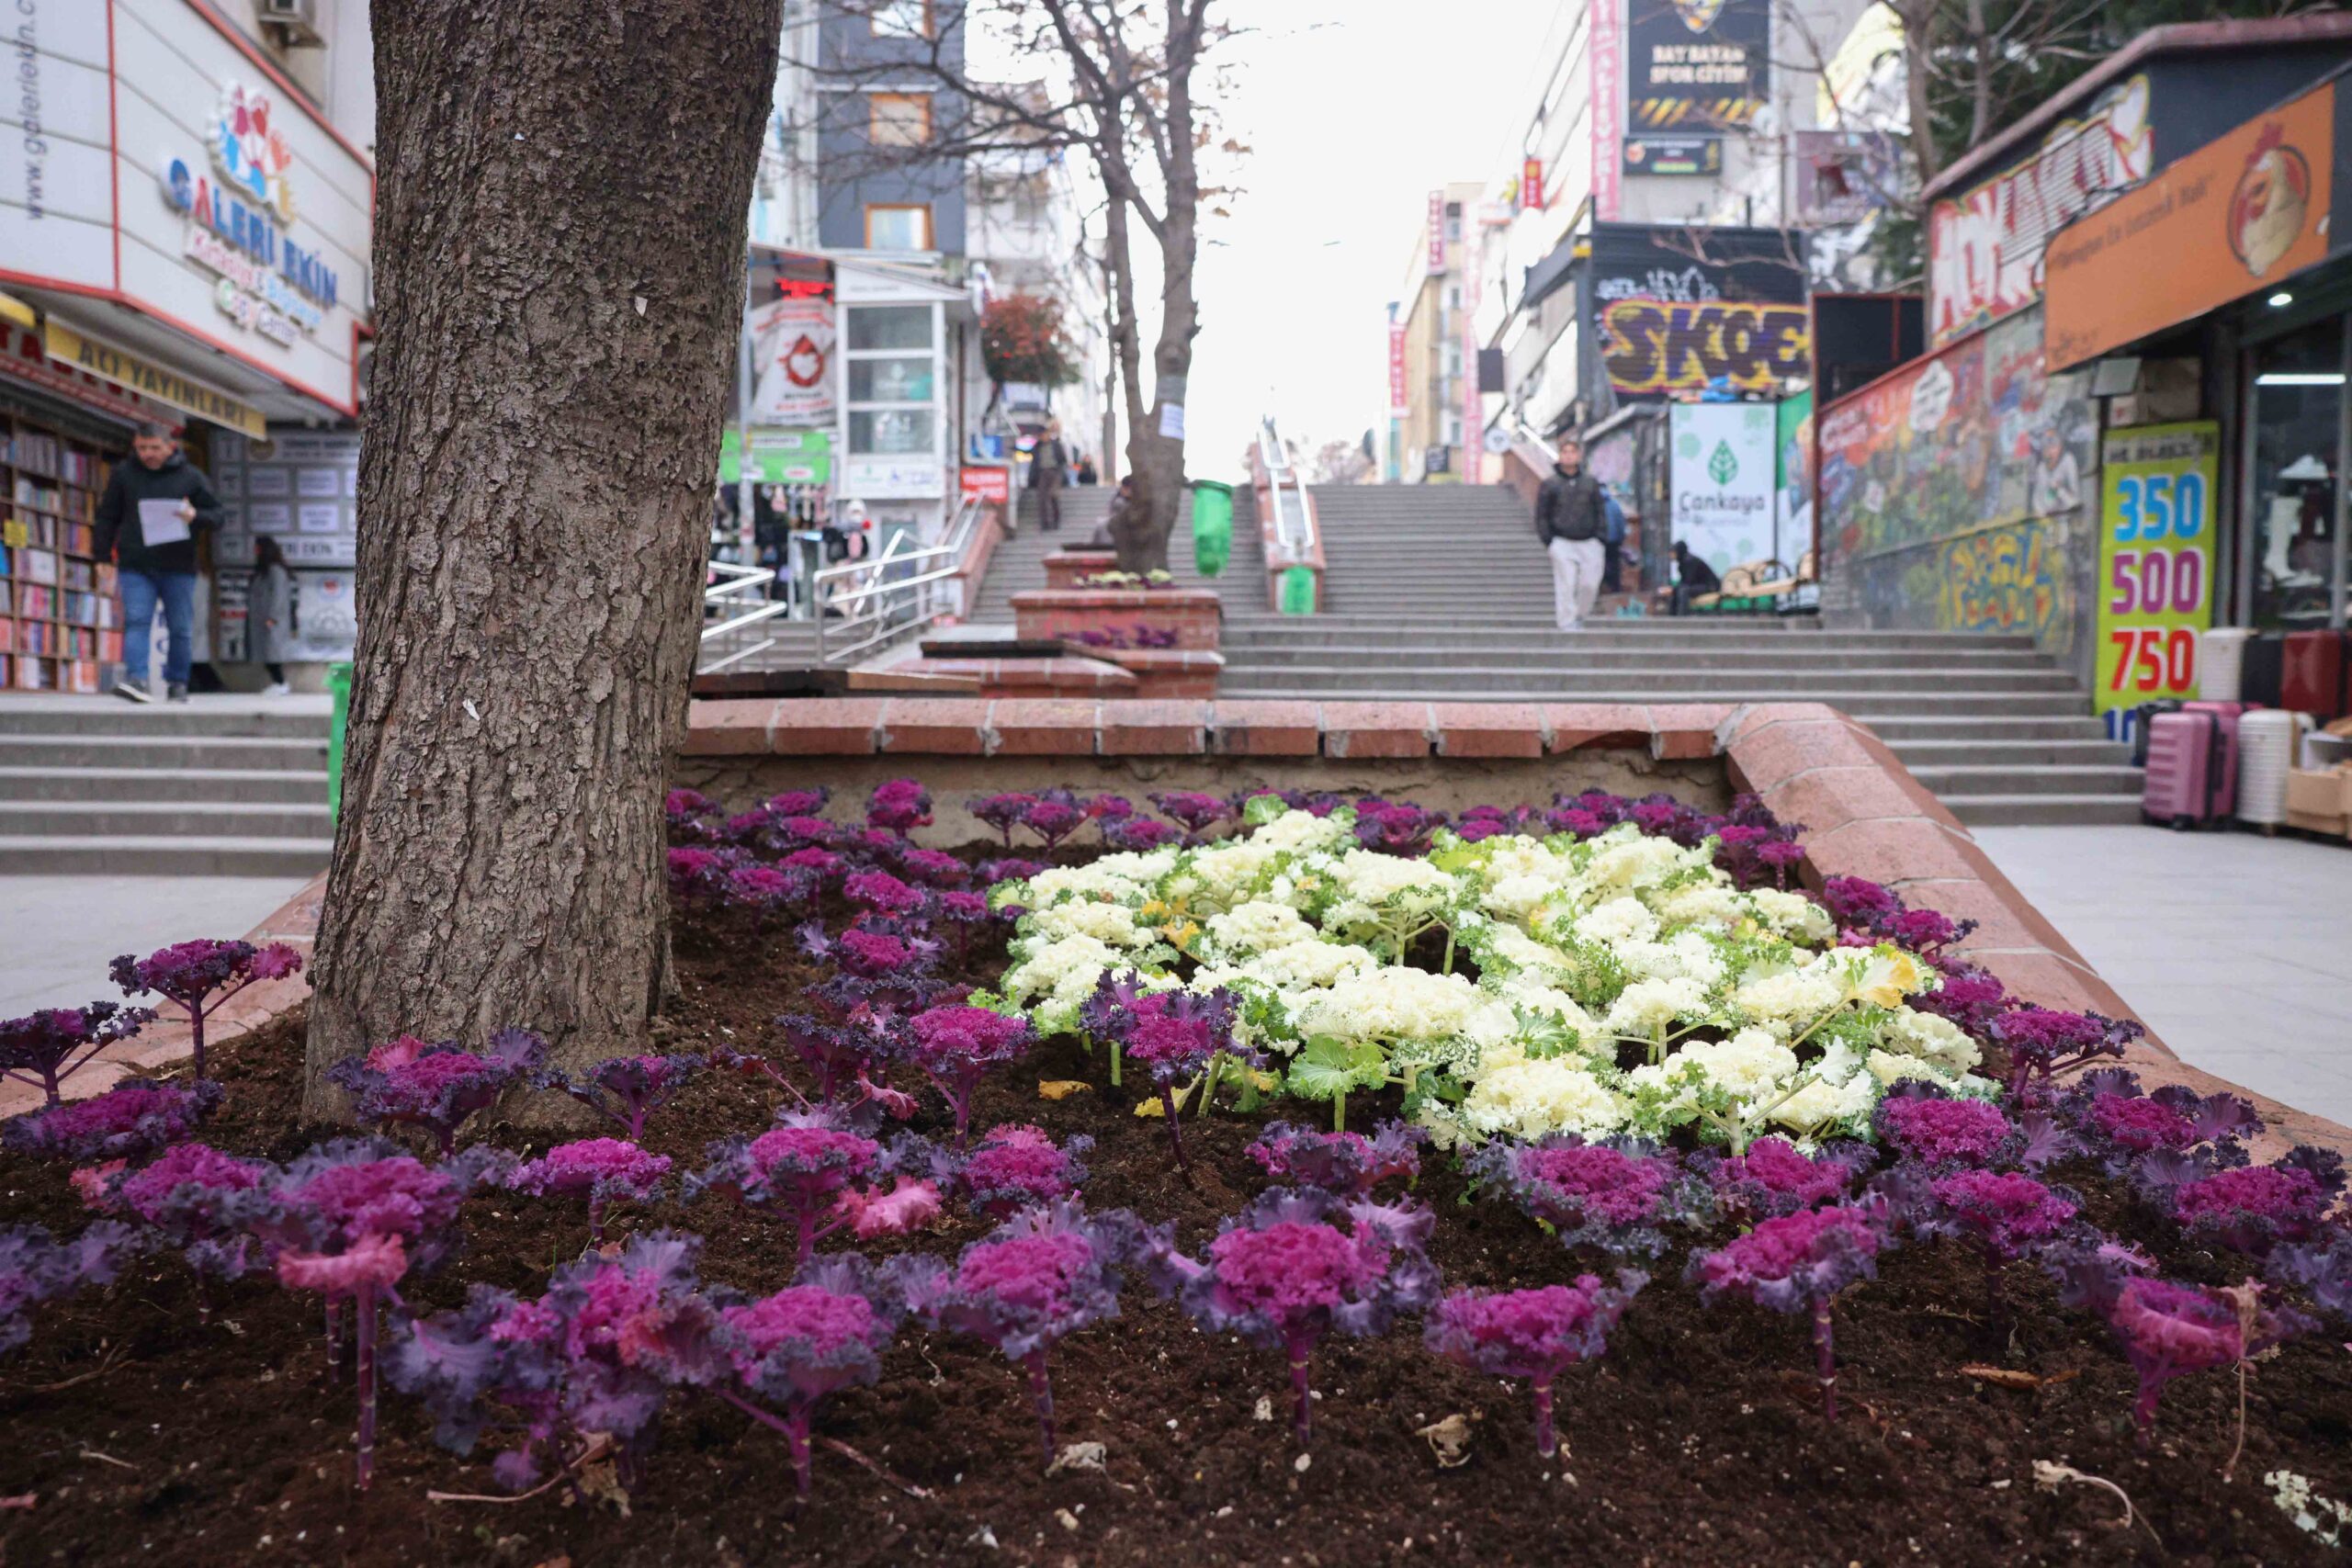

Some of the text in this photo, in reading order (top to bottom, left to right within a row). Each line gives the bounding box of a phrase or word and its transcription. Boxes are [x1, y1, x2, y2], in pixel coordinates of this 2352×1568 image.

[283, 237, 337, 309] EKİN
[1679, 490, 1765, 515] Çankaya
[2114, 473, 2205, 542] 350
[2110, 547, 2204, 615] 500
[2109, 626, 2199, 693] 750
